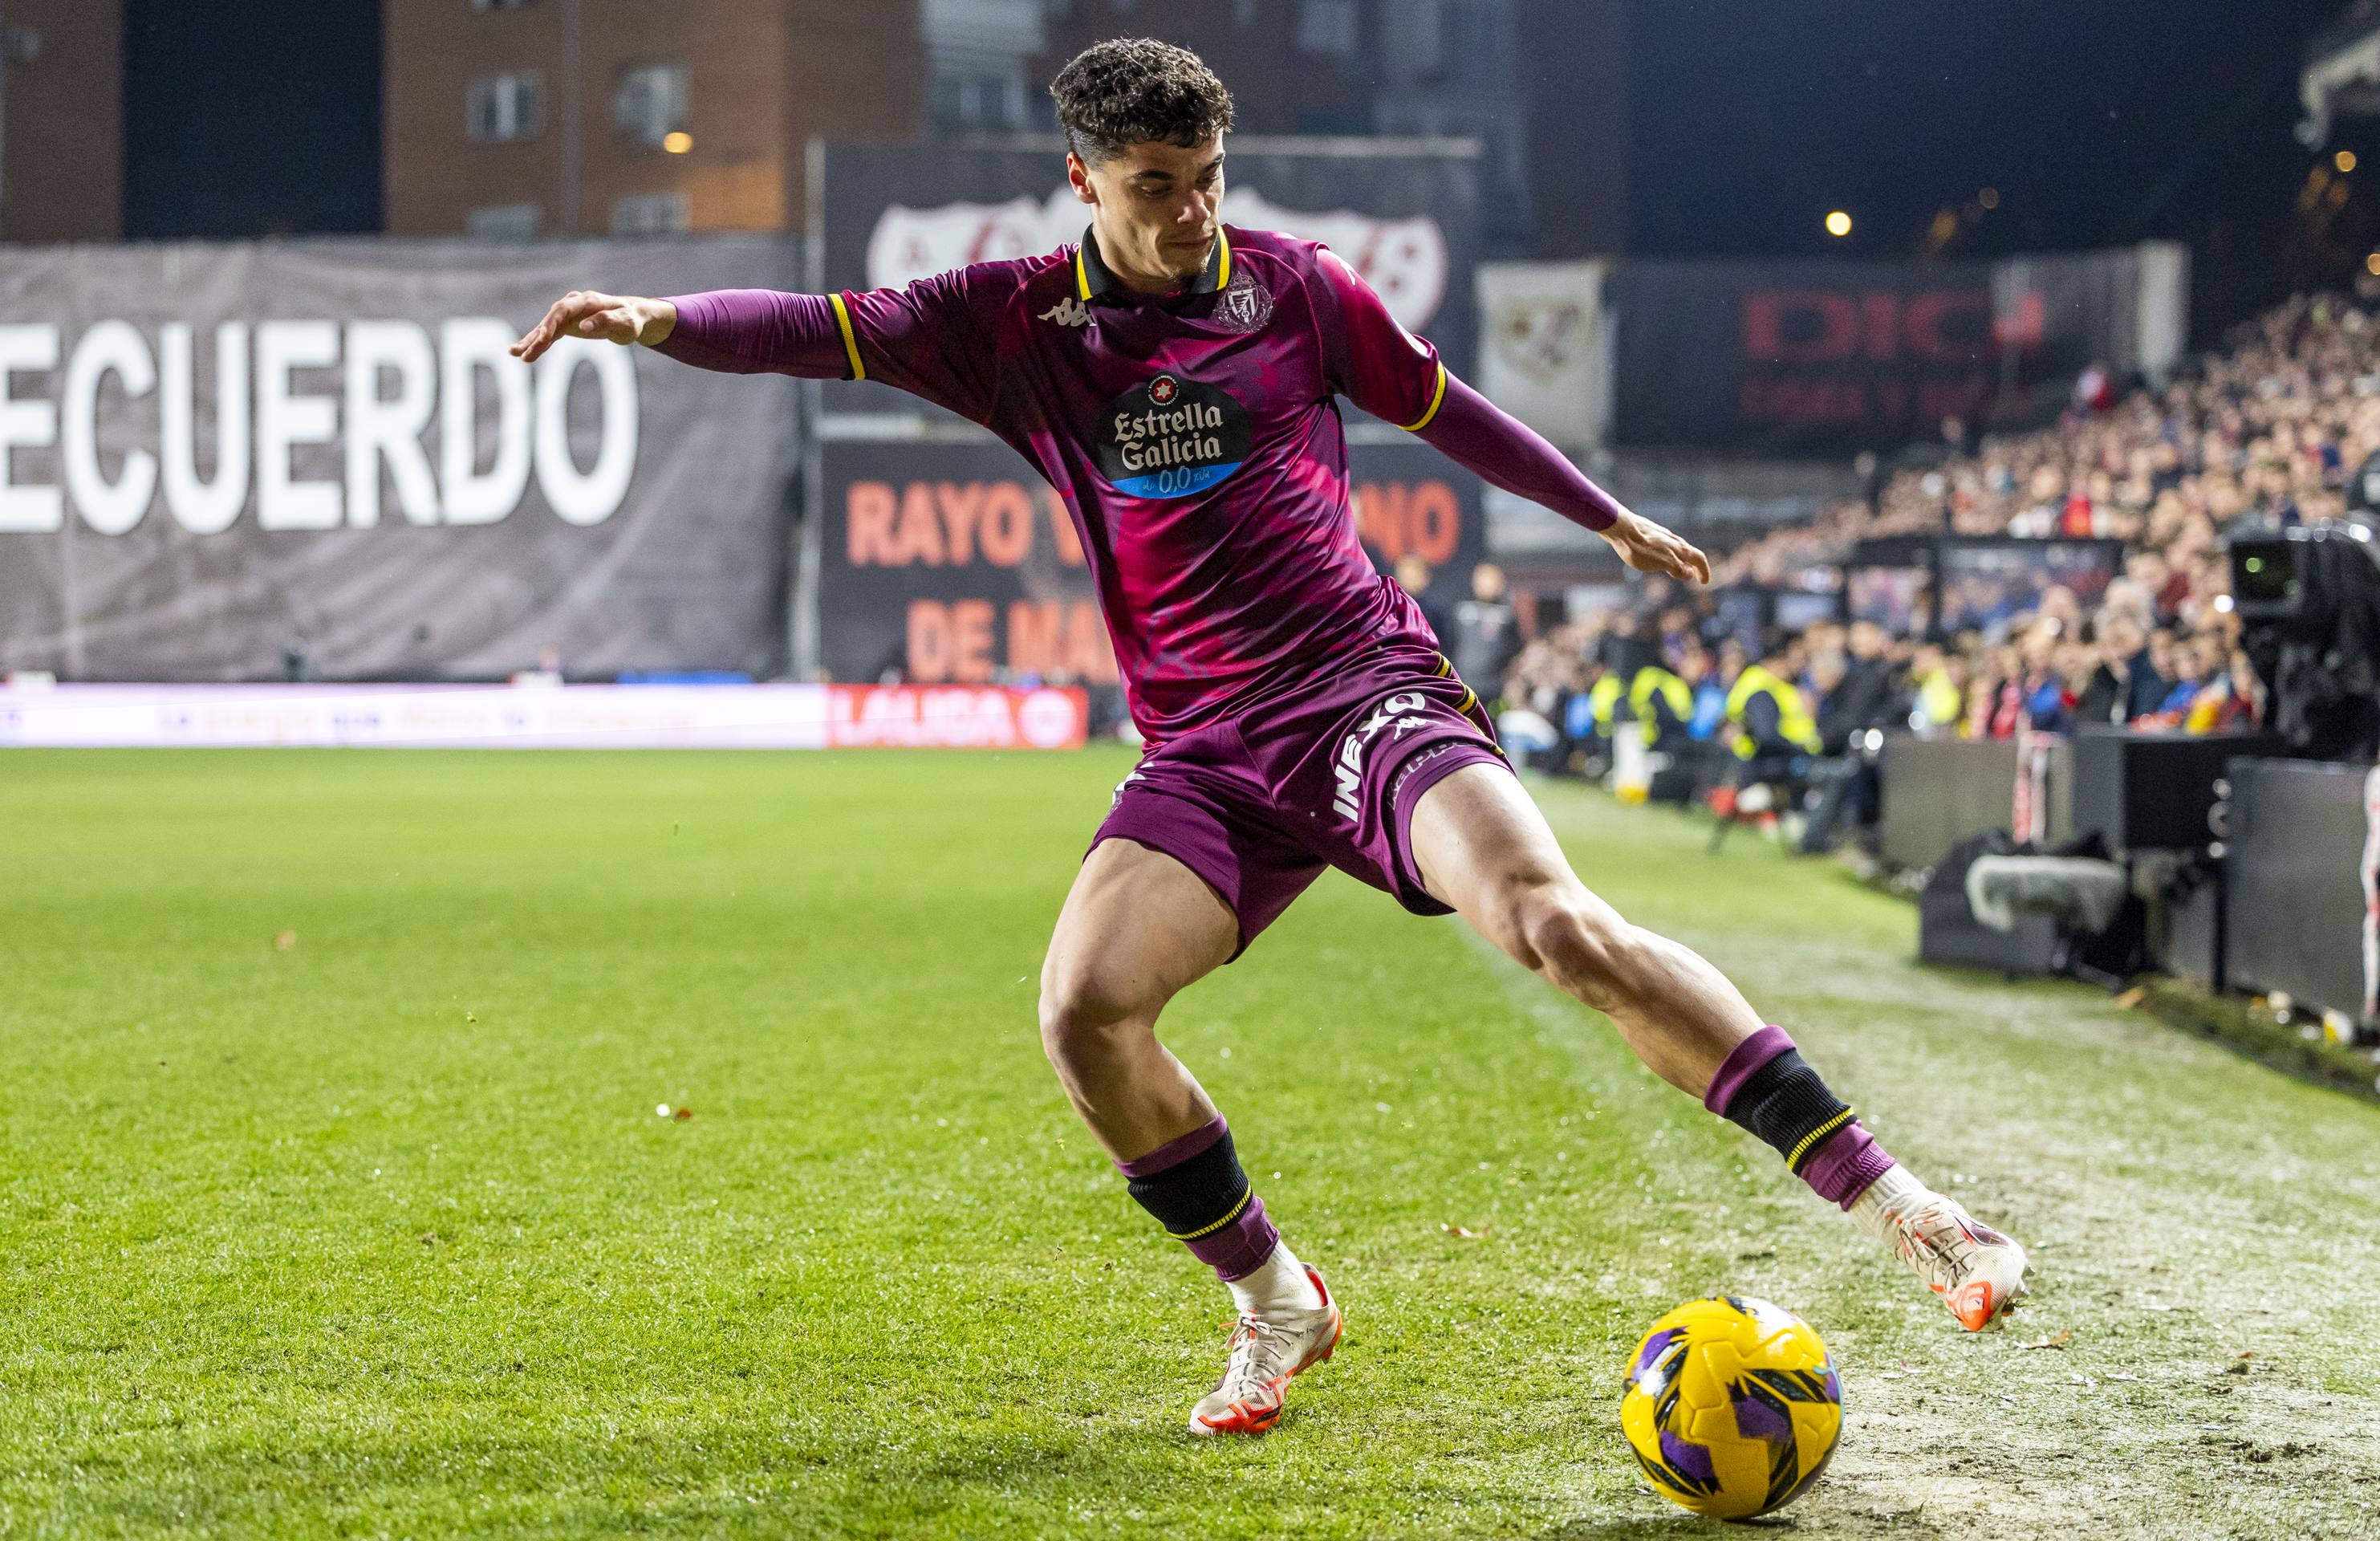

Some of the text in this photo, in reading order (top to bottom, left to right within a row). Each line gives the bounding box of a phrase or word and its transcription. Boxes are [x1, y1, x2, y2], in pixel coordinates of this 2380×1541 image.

[1114, 402, 1224, 442] Estrella
[1121, 432, 1223, 470] Galicia
[1158, 466, 1191, 494] 0,0
[847, 479, 1033, 567] RAYO
[905, 599, 1120, 684] DE MA
[1332, 692, 1426, 823] INEXO
